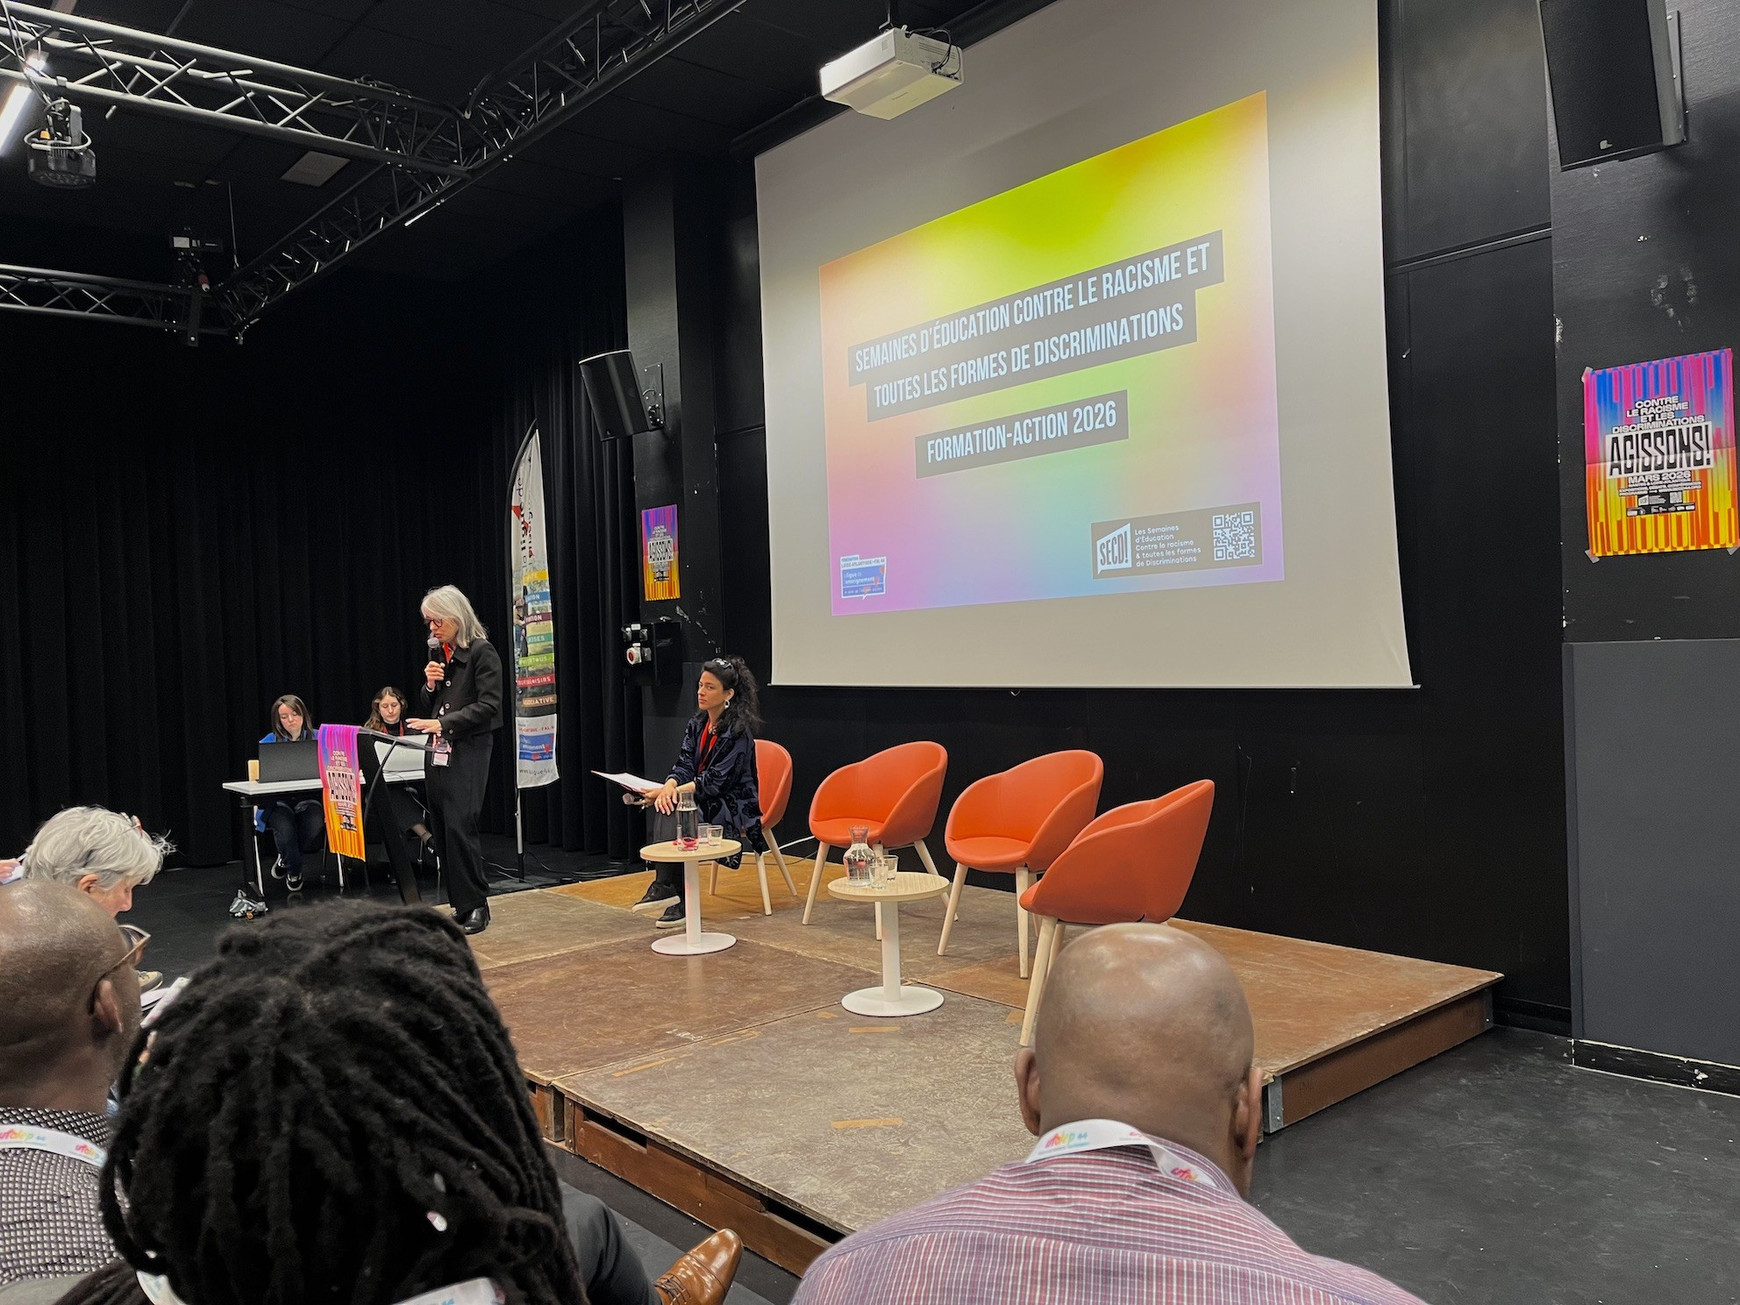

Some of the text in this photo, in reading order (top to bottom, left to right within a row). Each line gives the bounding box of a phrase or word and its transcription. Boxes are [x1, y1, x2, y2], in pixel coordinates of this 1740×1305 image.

[855, 242, 1210, 372] SEMAINES D'ÉDUCATION CONTRE LE RACISME ET
[874, 303, 1184, 408] TOUTES LES FORMES DE DISCRIMINATIONS
[1635, 395, 1679, 409] CONTRE
[1626, 402, 1689, 418] LE RACISME
[1640, 411, 1675, 423] ET LES
[927, 400, 1117, 464] FORMATION-ACTION 2026
[1612, 415, 1705, 434] DISCRIMINATIONS
[1609, 424, 1711, 476] AGISSONS!
[1628, 473, 1660, 484] MARS
[1661, 470, 1692, 481] 2026
[1147, 525, 1179, 534] Semaines
[1099, 530, 1129, 566] SECD!
[1135, 543, 1158, 552] Contre
[1142, 550, 1164, 558] toutes
[1165, 548, 1176, 556] les
[1176, 547, 1201, 555] formes
[1146, 556, 1197, 566] Discriminations
